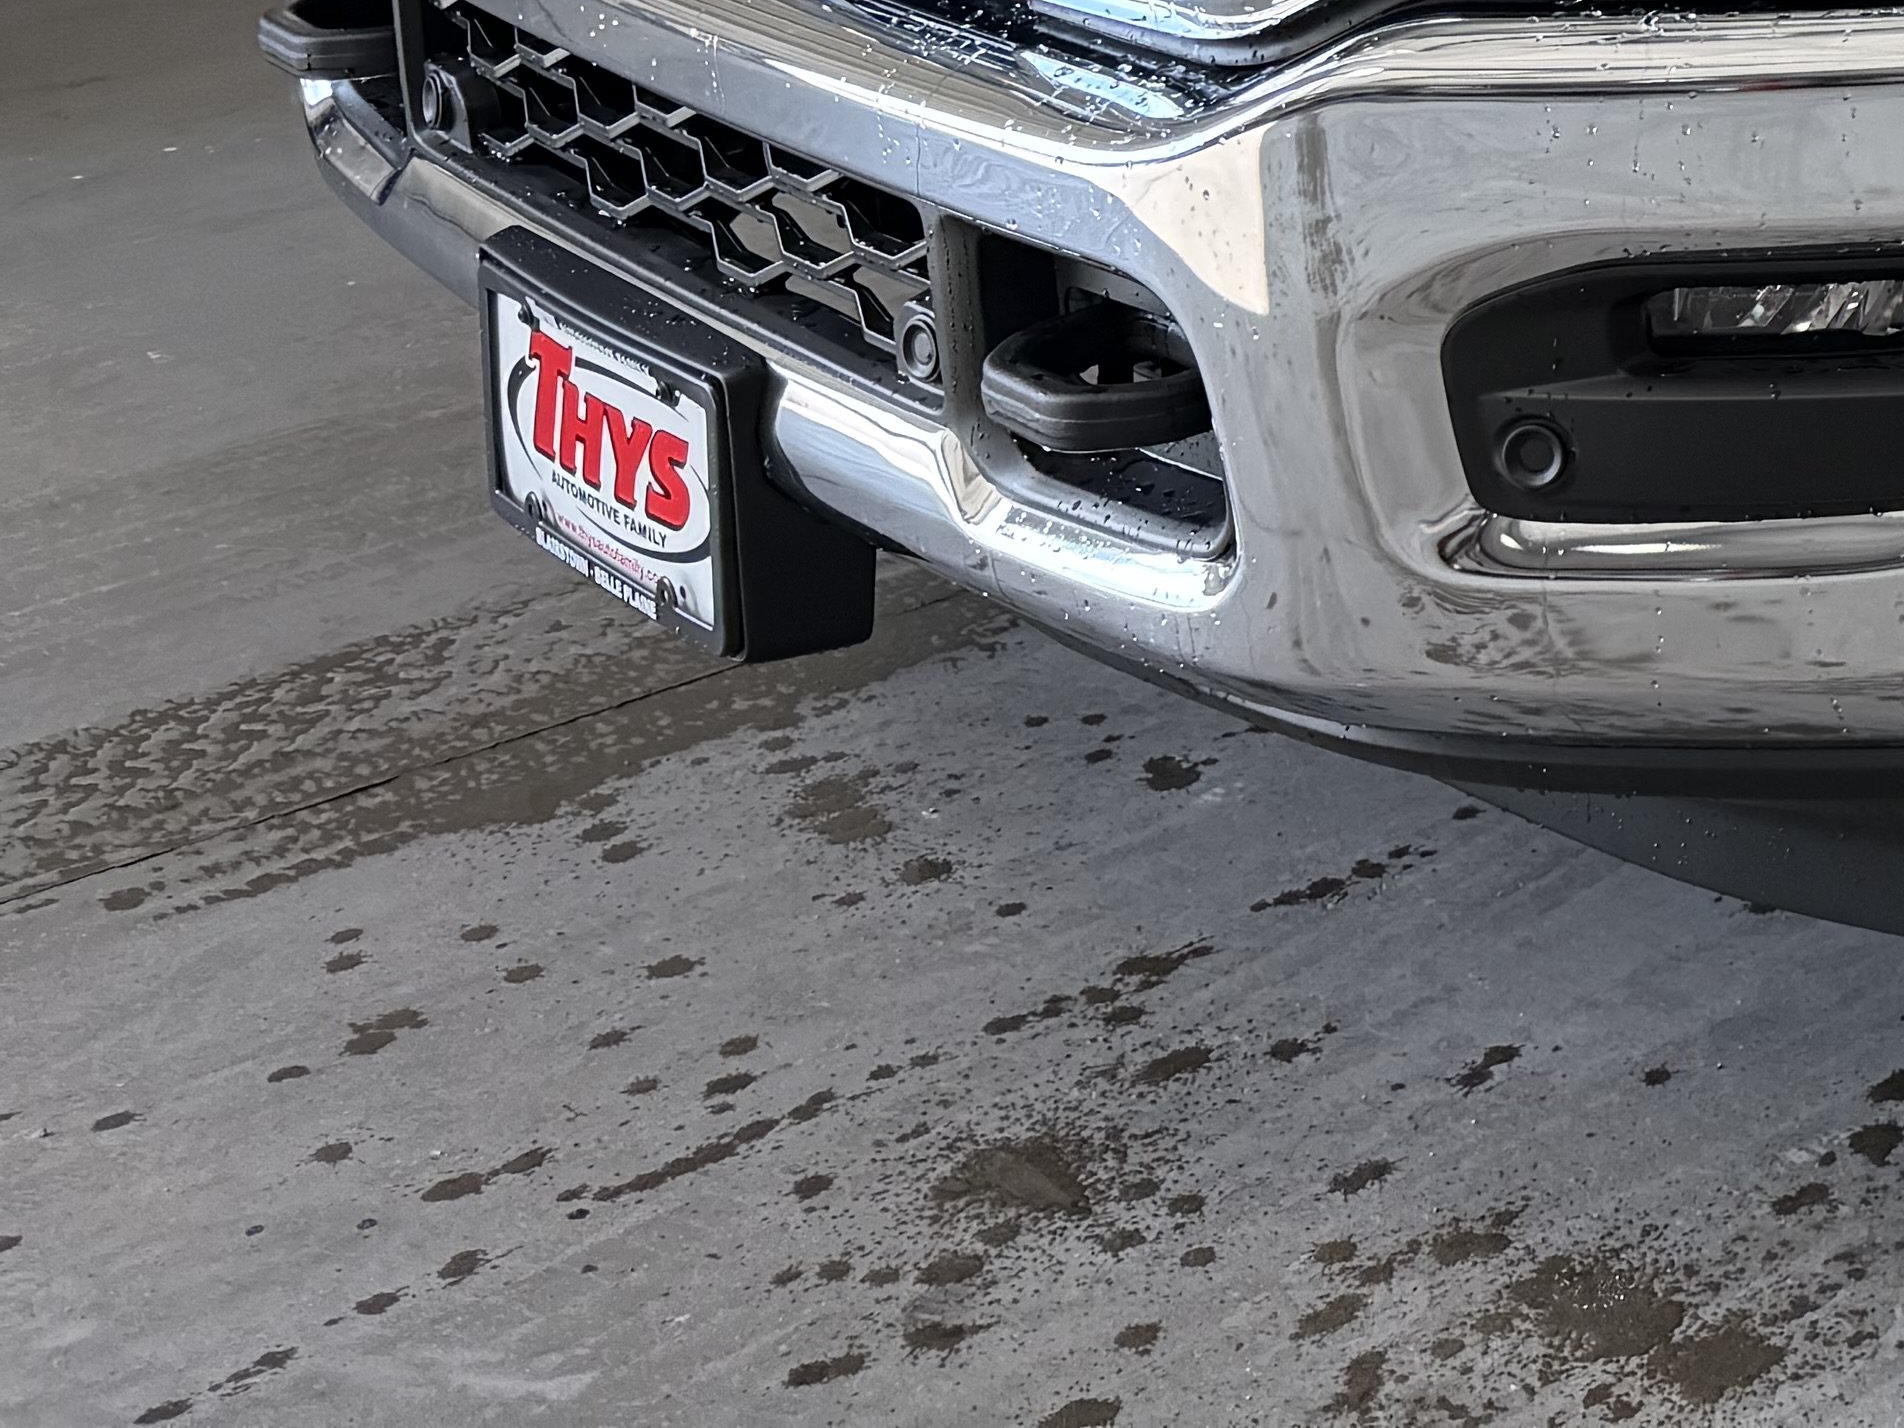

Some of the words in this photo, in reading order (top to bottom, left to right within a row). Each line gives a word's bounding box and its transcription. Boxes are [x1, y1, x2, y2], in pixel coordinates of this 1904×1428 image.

[529, 328, 691, 532] THYS
[551, 469, 622, 526] AUTOMOTIVE
[623, 513, 668, 548] FAMILY
